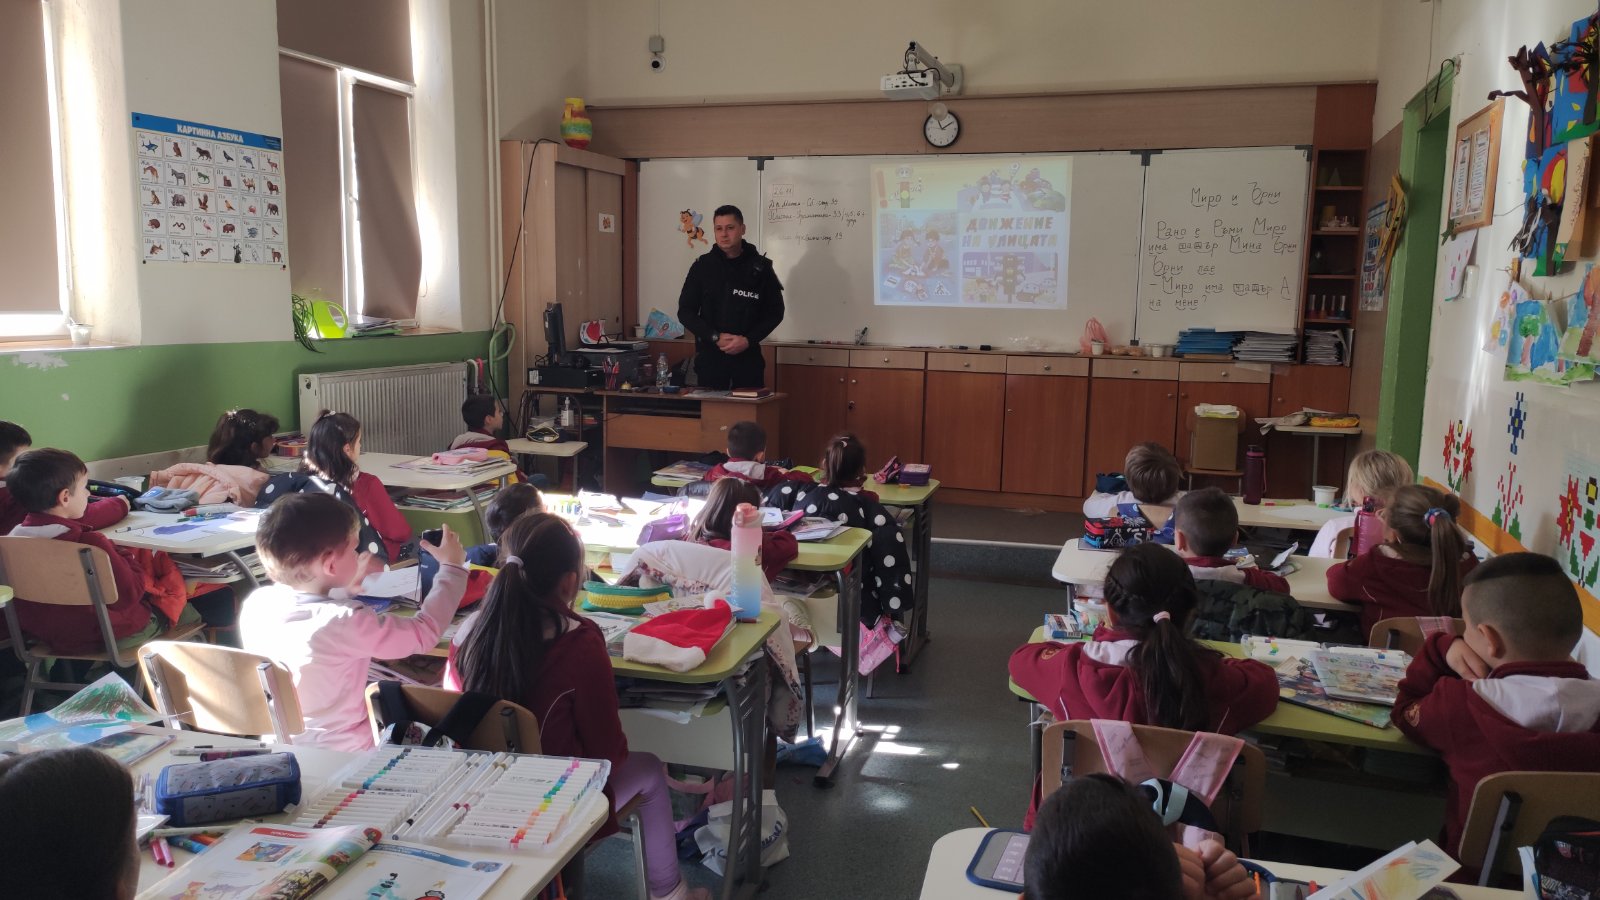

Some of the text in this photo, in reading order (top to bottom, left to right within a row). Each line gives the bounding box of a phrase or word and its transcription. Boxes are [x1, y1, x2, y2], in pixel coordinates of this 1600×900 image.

[177, 123, 244, 143] КАРТИННА АЗБУКА
[1191, 187, 1222, 212] Миро
[965, 216, 1054, 233] ДВИЖЕНИЕ
[1157, 220, 1187, 237] Рано
[1253, 217, 1287, 239] Миро
[961, 234, 1058, 250] НА УЛИЦАТА
[1230, 235, 1262, 250] Мина
[1197, 264, 1216, 273] лае
[732, 288, 760, 300] POLICE
[1162, 276, 1194, 297] Миро
[1205, 283, 1224, 292] има
[1280, 276, 1290, 295] А
[1149, 299, 1161, 308] на
